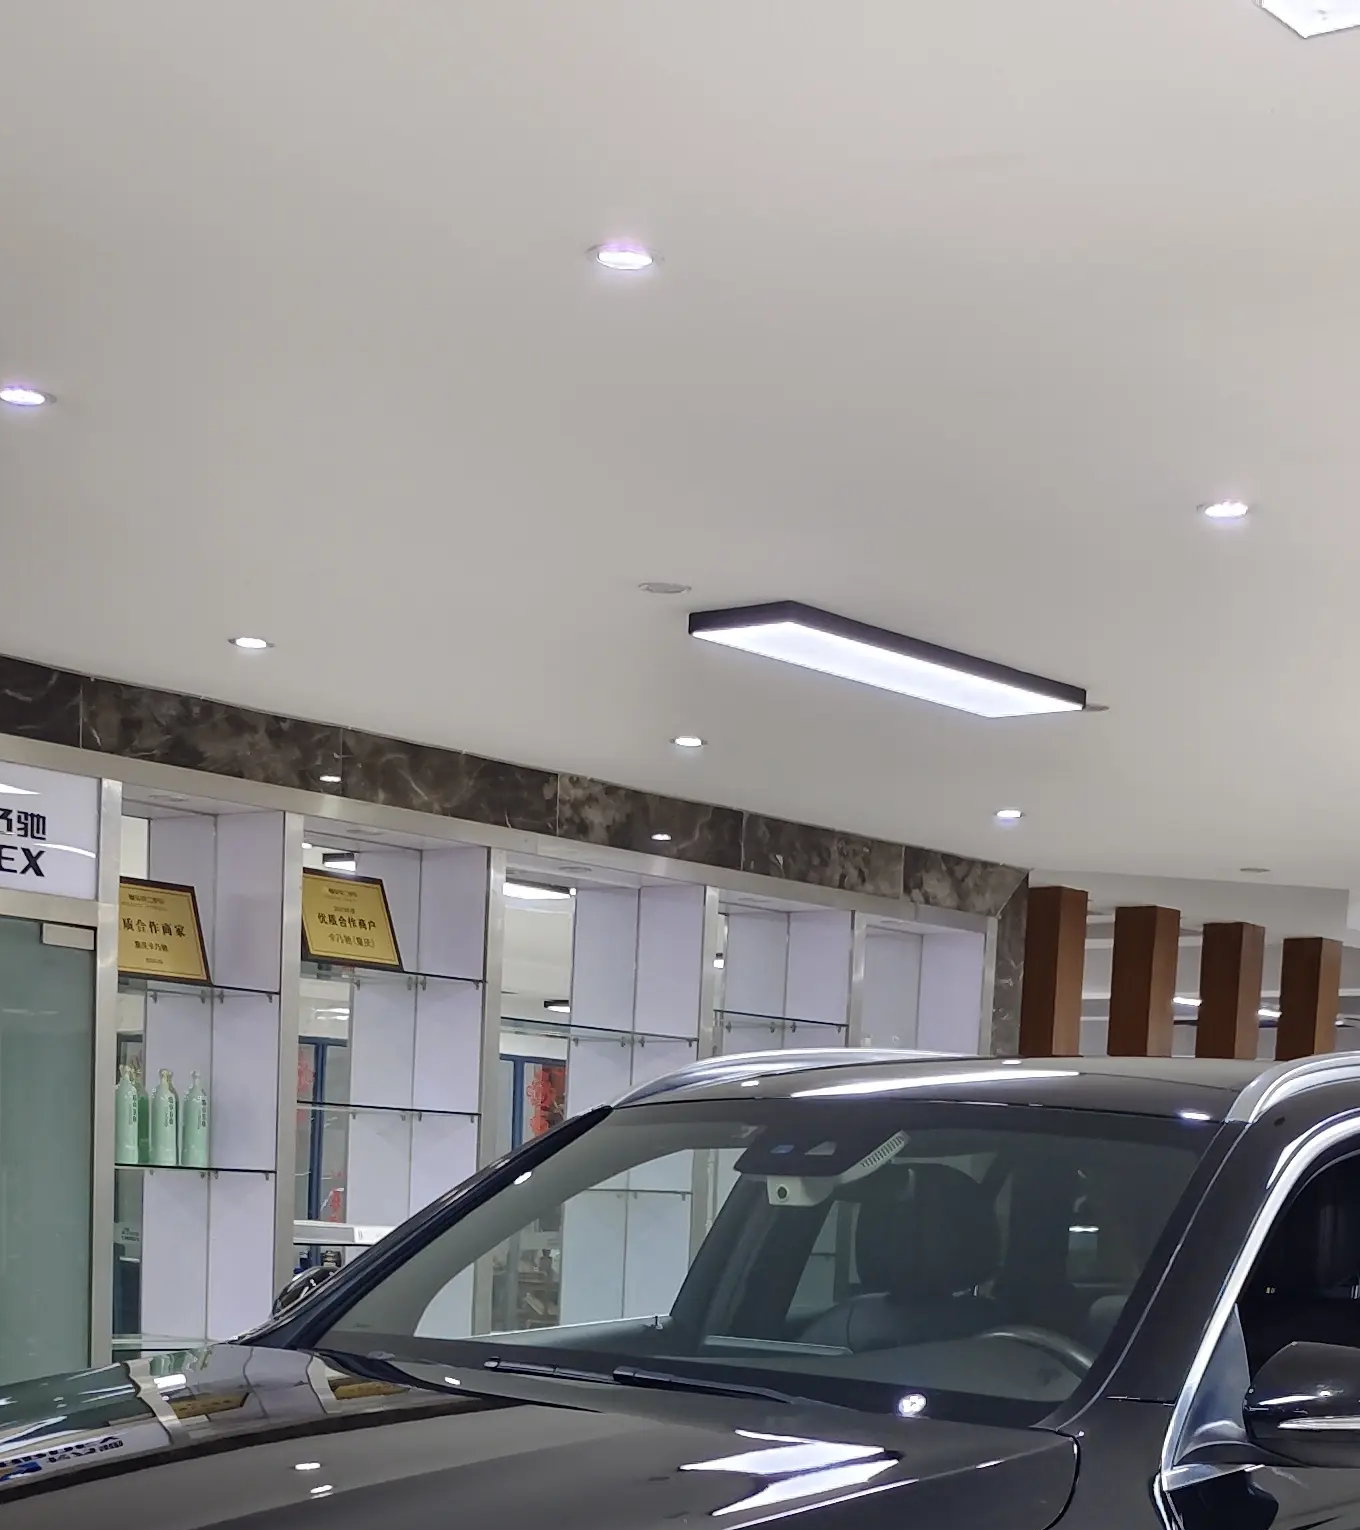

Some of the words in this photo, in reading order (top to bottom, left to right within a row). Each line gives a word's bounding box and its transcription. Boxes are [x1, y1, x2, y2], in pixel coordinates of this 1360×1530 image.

[122, 917, 186, 938] 质合作商家
